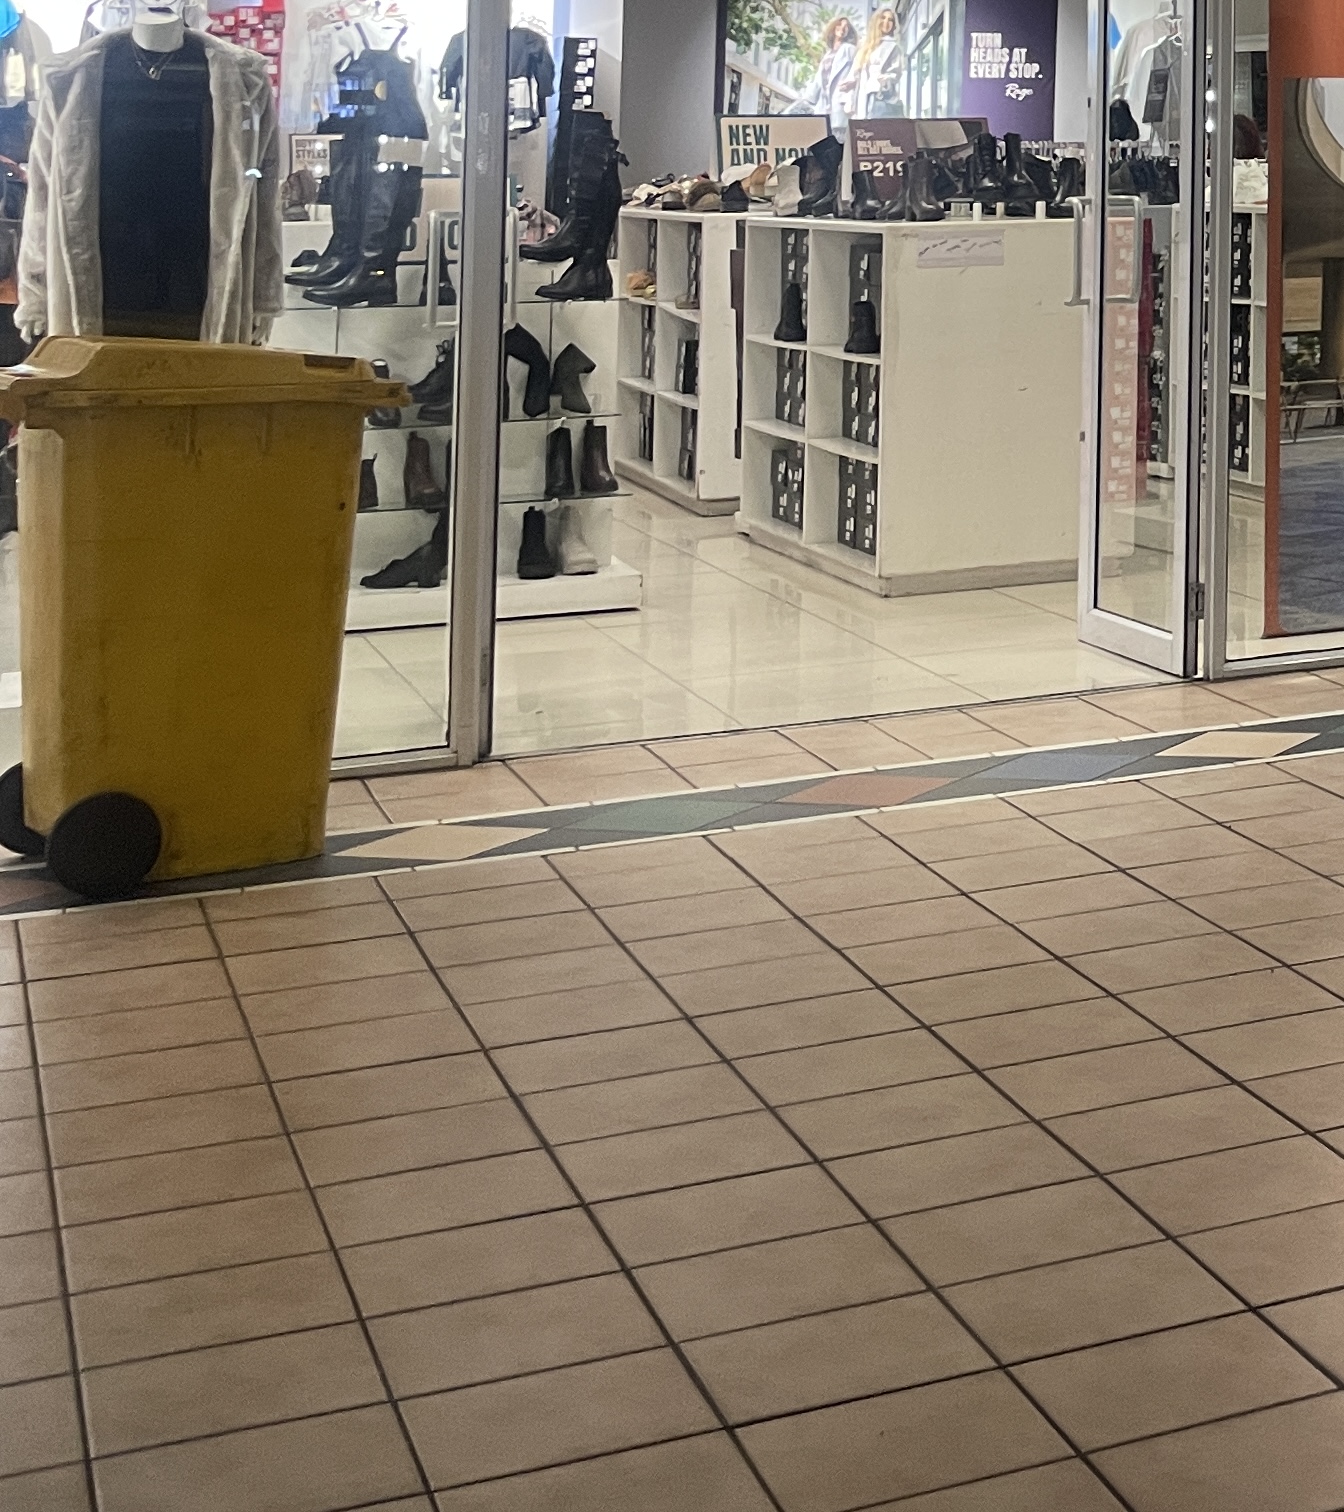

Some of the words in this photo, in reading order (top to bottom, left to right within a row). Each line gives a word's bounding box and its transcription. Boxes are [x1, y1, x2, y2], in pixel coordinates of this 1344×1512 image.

[970, 32, 1003, 48] TURN
[970, 48, 1010, 63] HEADS
[1011, 48, 1028, 63] AT
[969, 63, 1008, 79] EVERY
[1008, 63, 1043, 79] STOP.
[728, 124, 770, 146] NEW
[730, 148, 768, 166] AND
